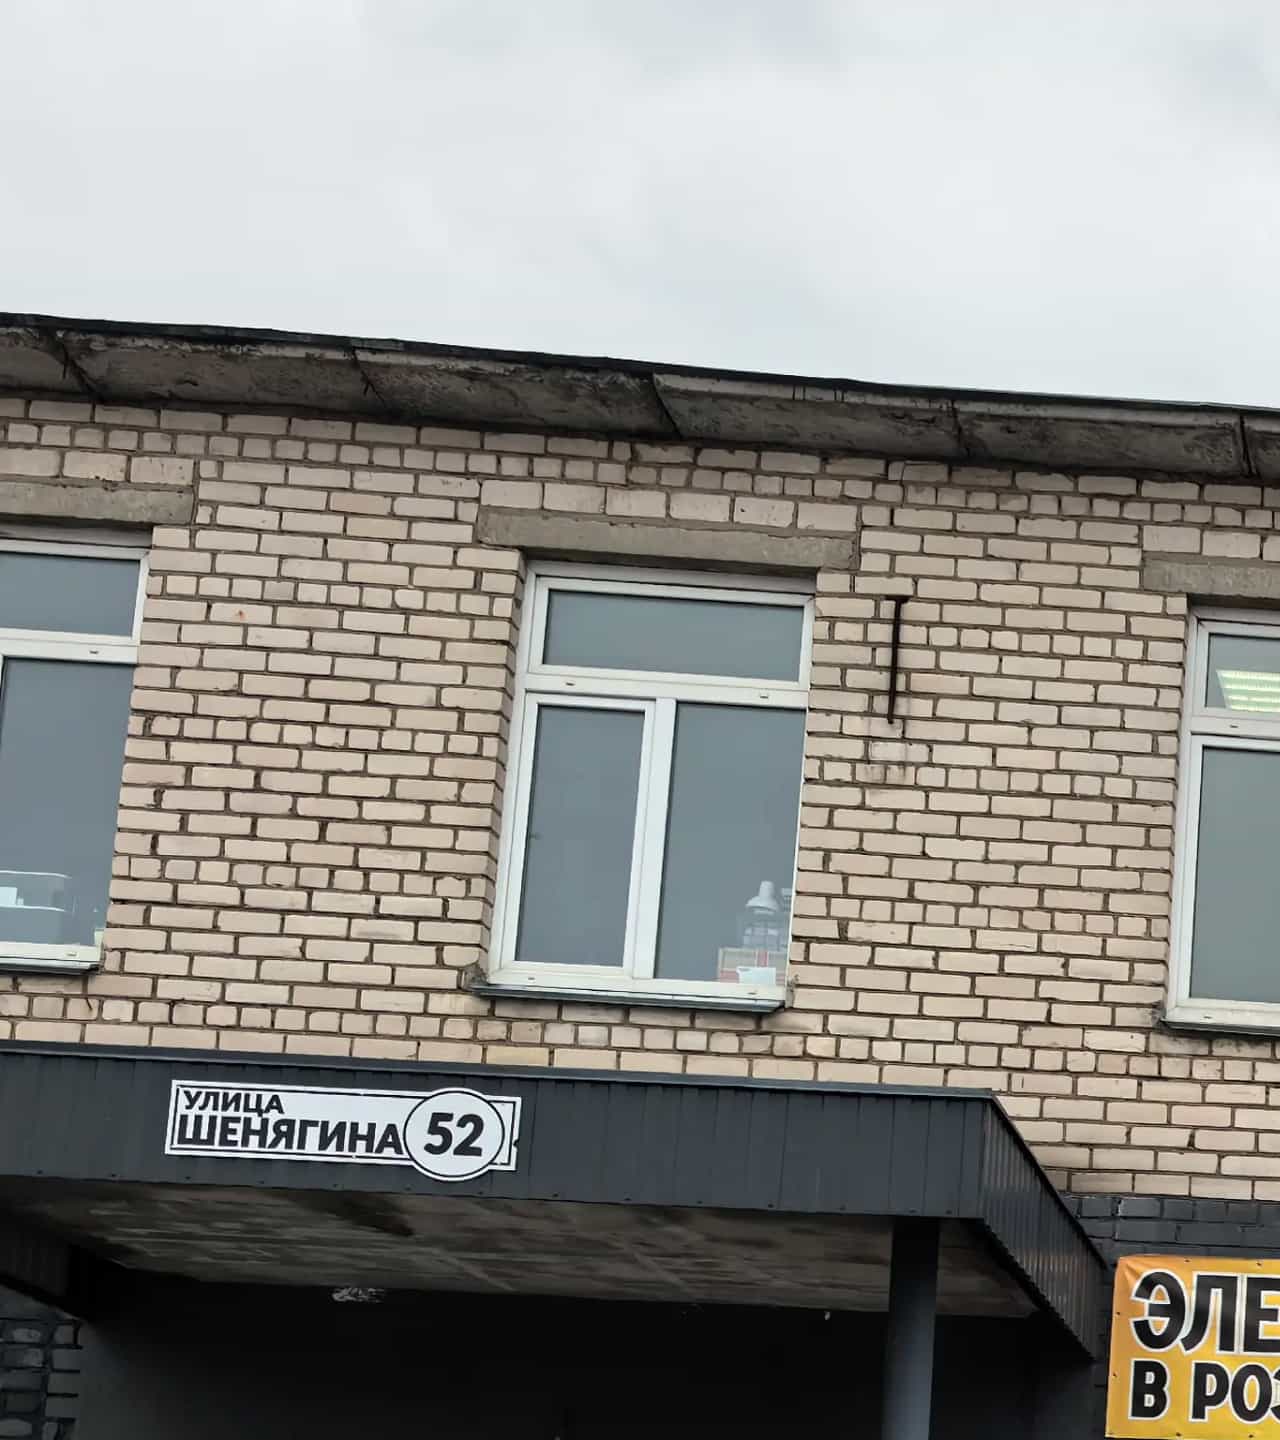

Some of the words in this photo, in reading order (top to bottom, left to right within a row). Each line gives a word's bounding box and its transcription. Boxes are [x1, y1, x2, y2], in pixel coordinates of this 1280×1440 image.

[183, 1090, 285, 1117] УЛИЦА
[176, 1114, 404, 1155] ШЕНЯГИНА
[423, 1111, 485, 1158] 52
[1130, 1359, 1168, 1419] В
